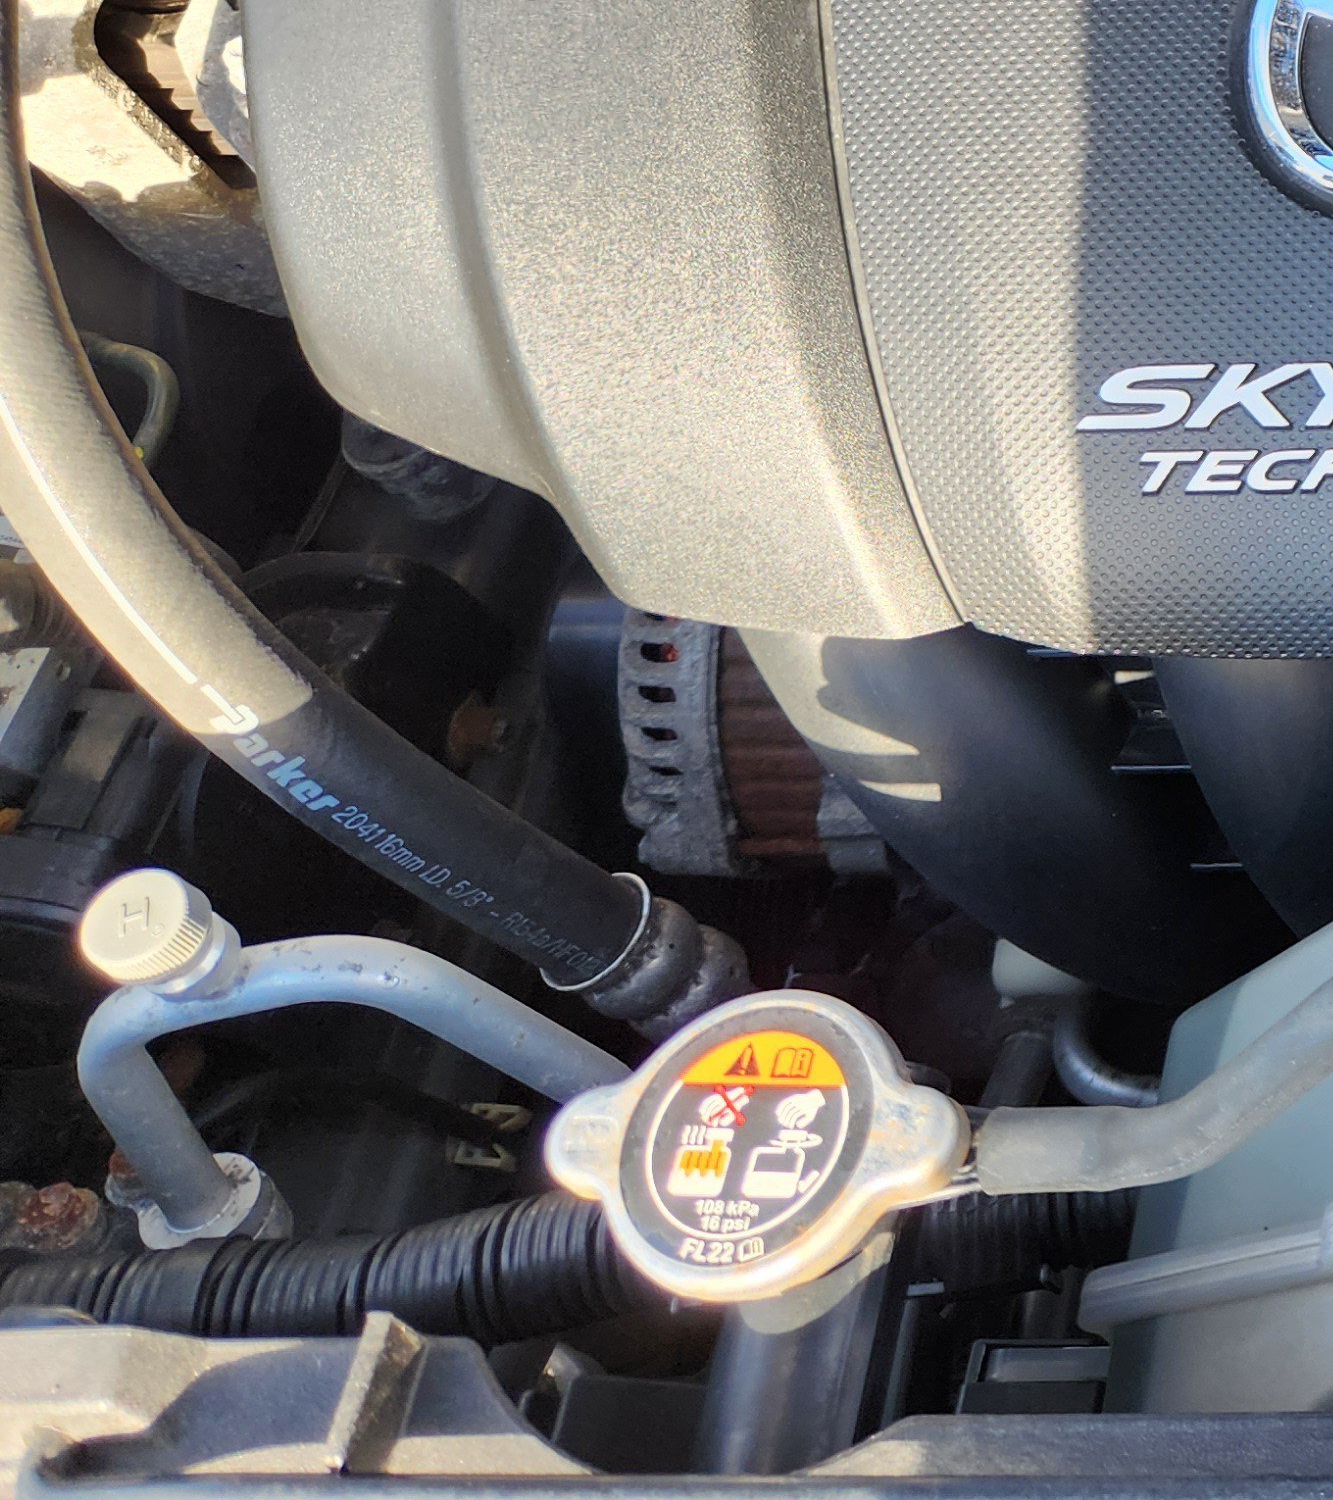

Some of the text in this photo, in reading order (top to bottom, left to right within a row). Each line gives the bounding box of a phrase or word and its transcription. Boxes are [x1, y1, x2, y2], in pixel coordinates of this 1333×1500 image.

[201, 684, 341, 811] Parker
[331, 805, 387, 843] 2041
[374, 833, 426, 873] 16mm
[695, 1199, 760, 1219] 108 kPa
[701, 1215, 751, 1234] 16 psi
[679, 1237, 735, 1265] FL22
